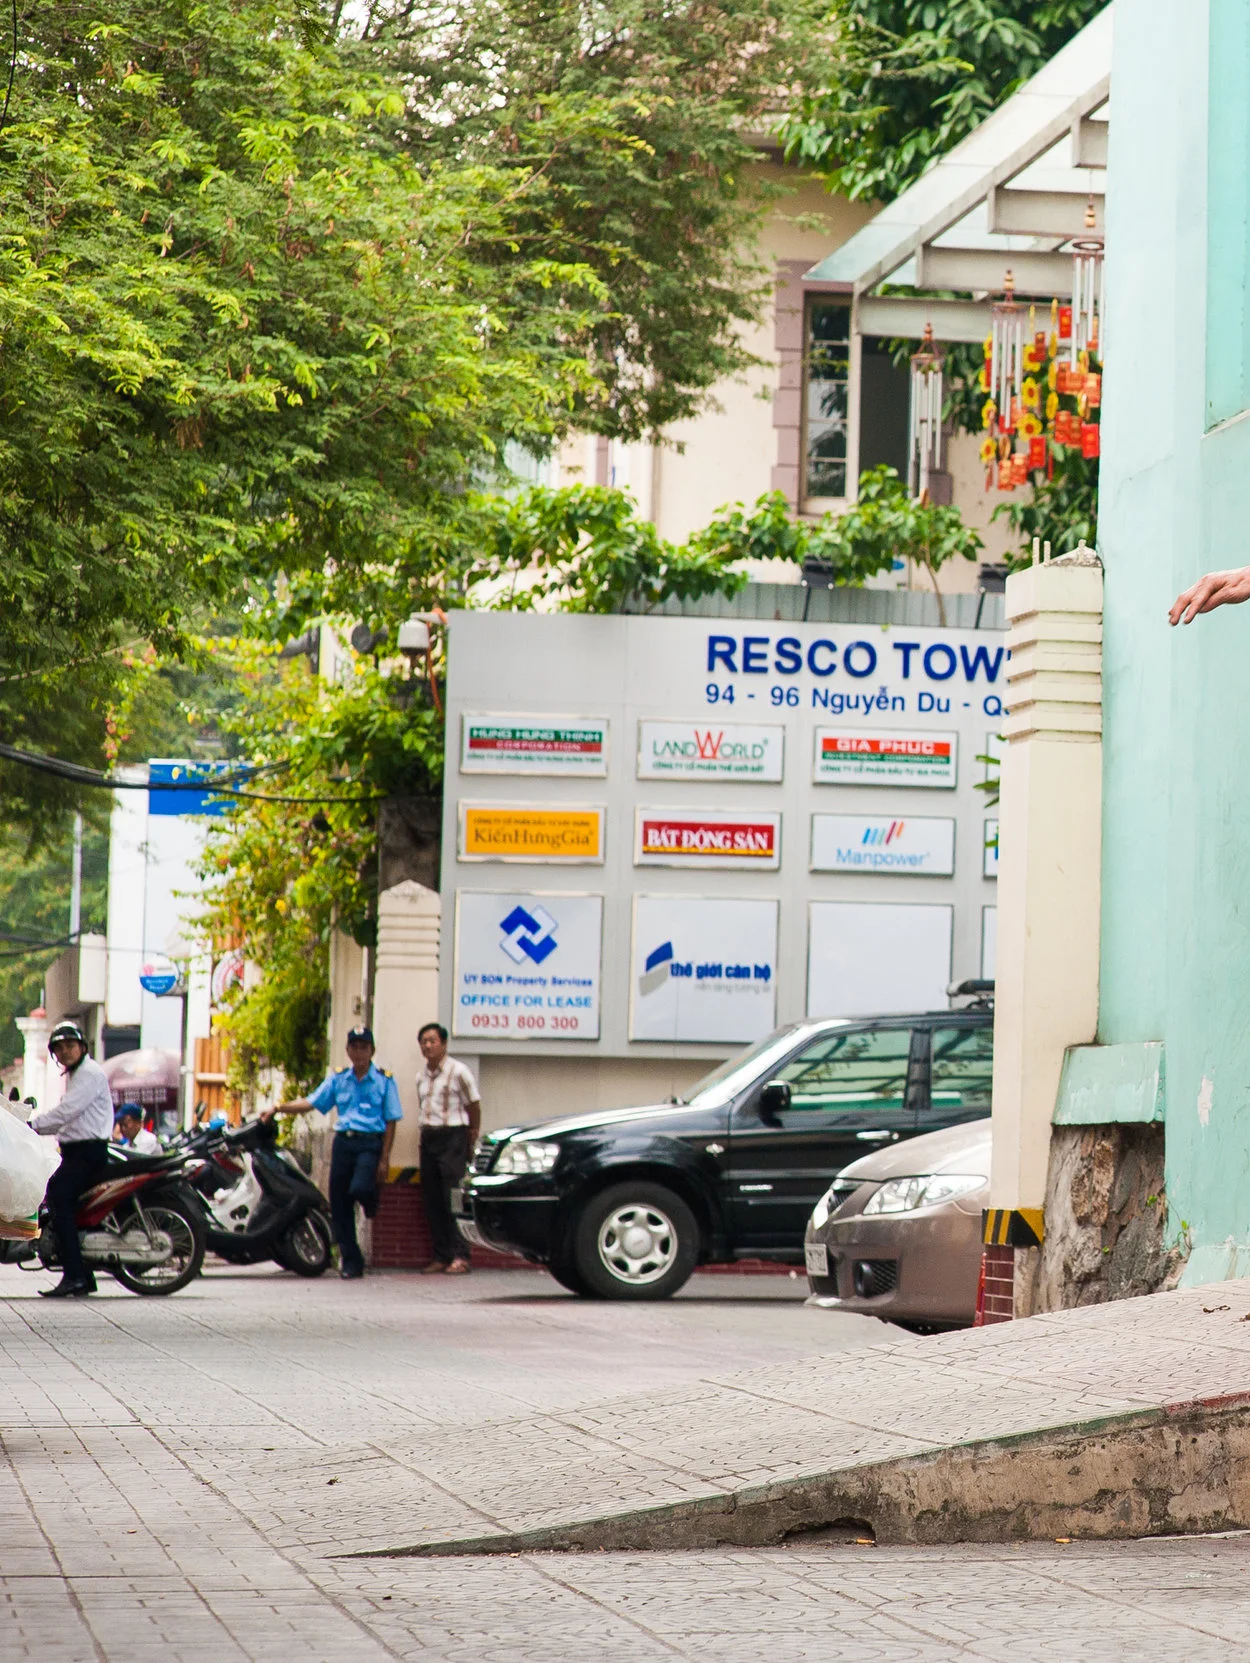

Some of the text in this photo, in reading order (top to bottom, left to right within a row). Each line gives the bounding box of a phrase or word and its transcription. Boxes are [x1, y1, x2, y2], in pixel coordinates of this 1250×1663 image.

[706, 635, 1012, 685] RESCO TOW
[705, 683, 736, 705] 94
[770, 686, 800, 707] 96
[812, 686, 905, 715] Nguyễn
[918, 692, 950, 713] Du
[983, 695, 1010, 717] Q
[836, 738, 871, 752] GIA
[836, 848, 925, 867] Manpower
[460, 993, 592, 1008] OFFICE FOR LEASE
[471, 1013, 579, 1030] 0933 800 300
